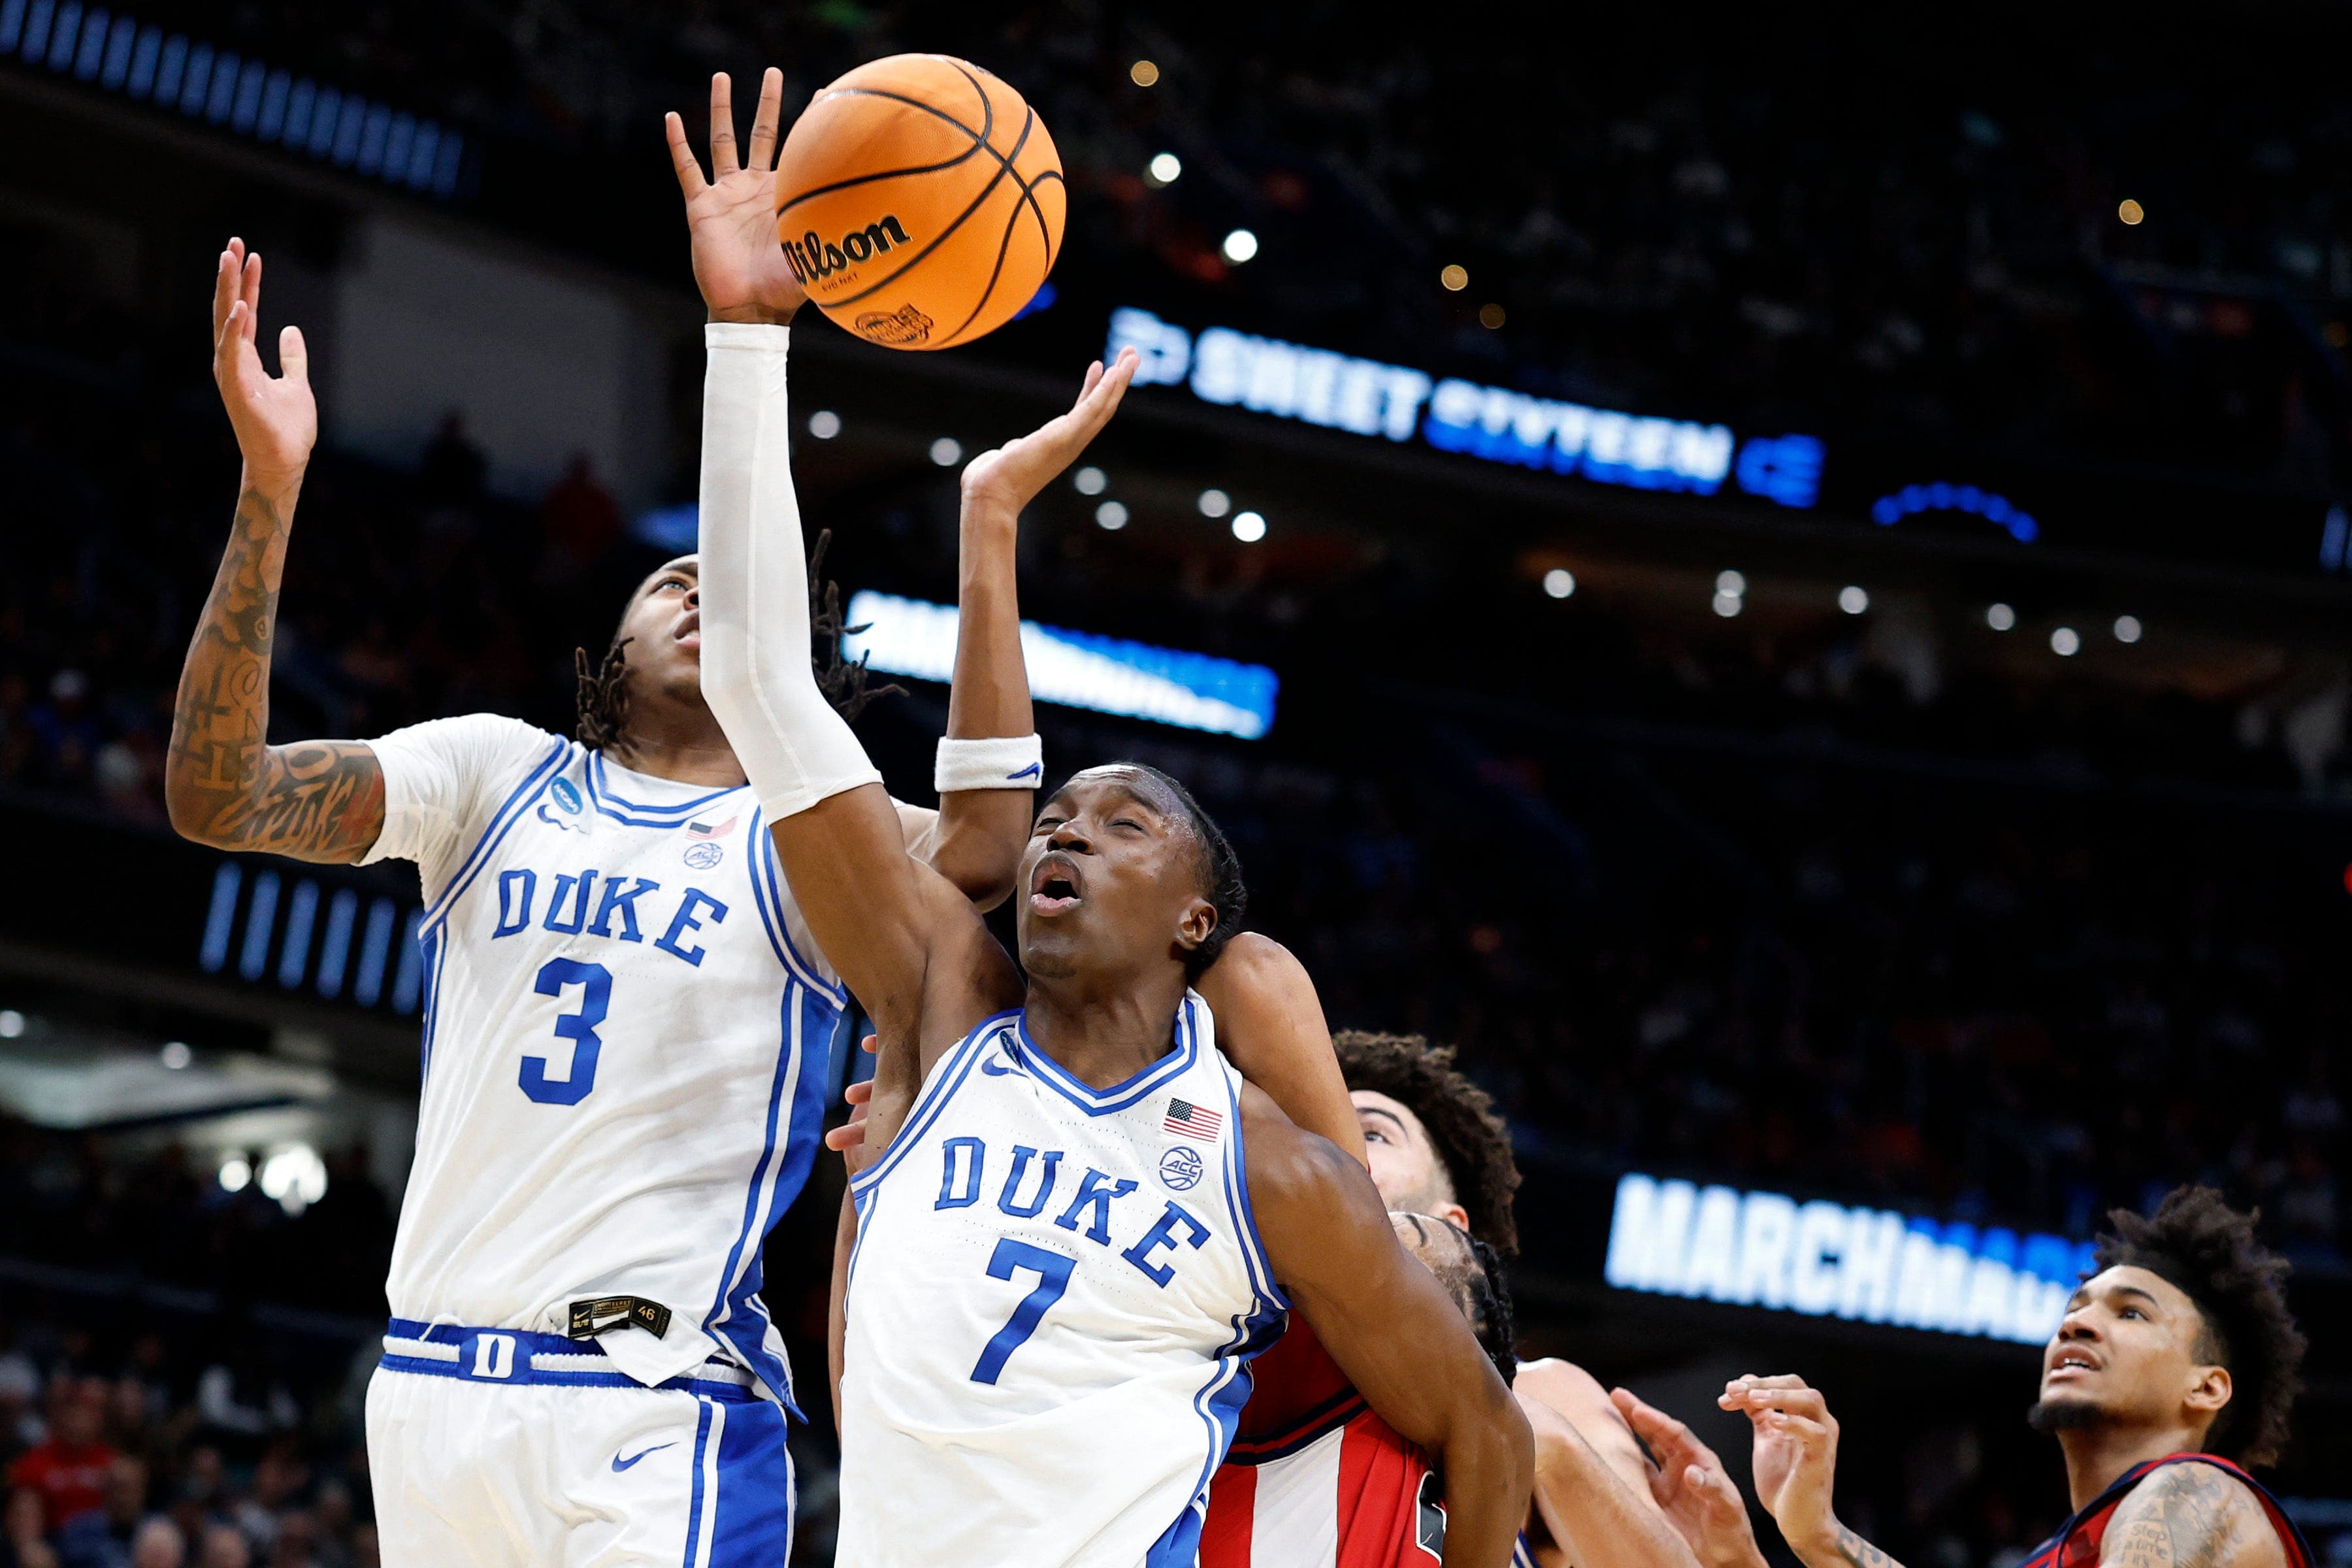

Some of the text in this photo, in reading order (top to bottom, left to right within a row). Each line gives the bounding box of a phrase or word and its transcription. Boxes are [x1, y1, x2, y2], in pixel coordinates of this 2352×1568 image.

[553, 783, 579, 813] NCAA
[491, 869, 728, 967] DUKE
[519, 957, 613, 1106] 3
[934, 1137, 1211, 1289] DUKE
[1165, 1160, 1202, 1175] ACC
[1604, 1172, 1906, 1325] MARCH
[638, 1305, 655, 1321] 46
[970, 1237, 1077, 1386] 7
